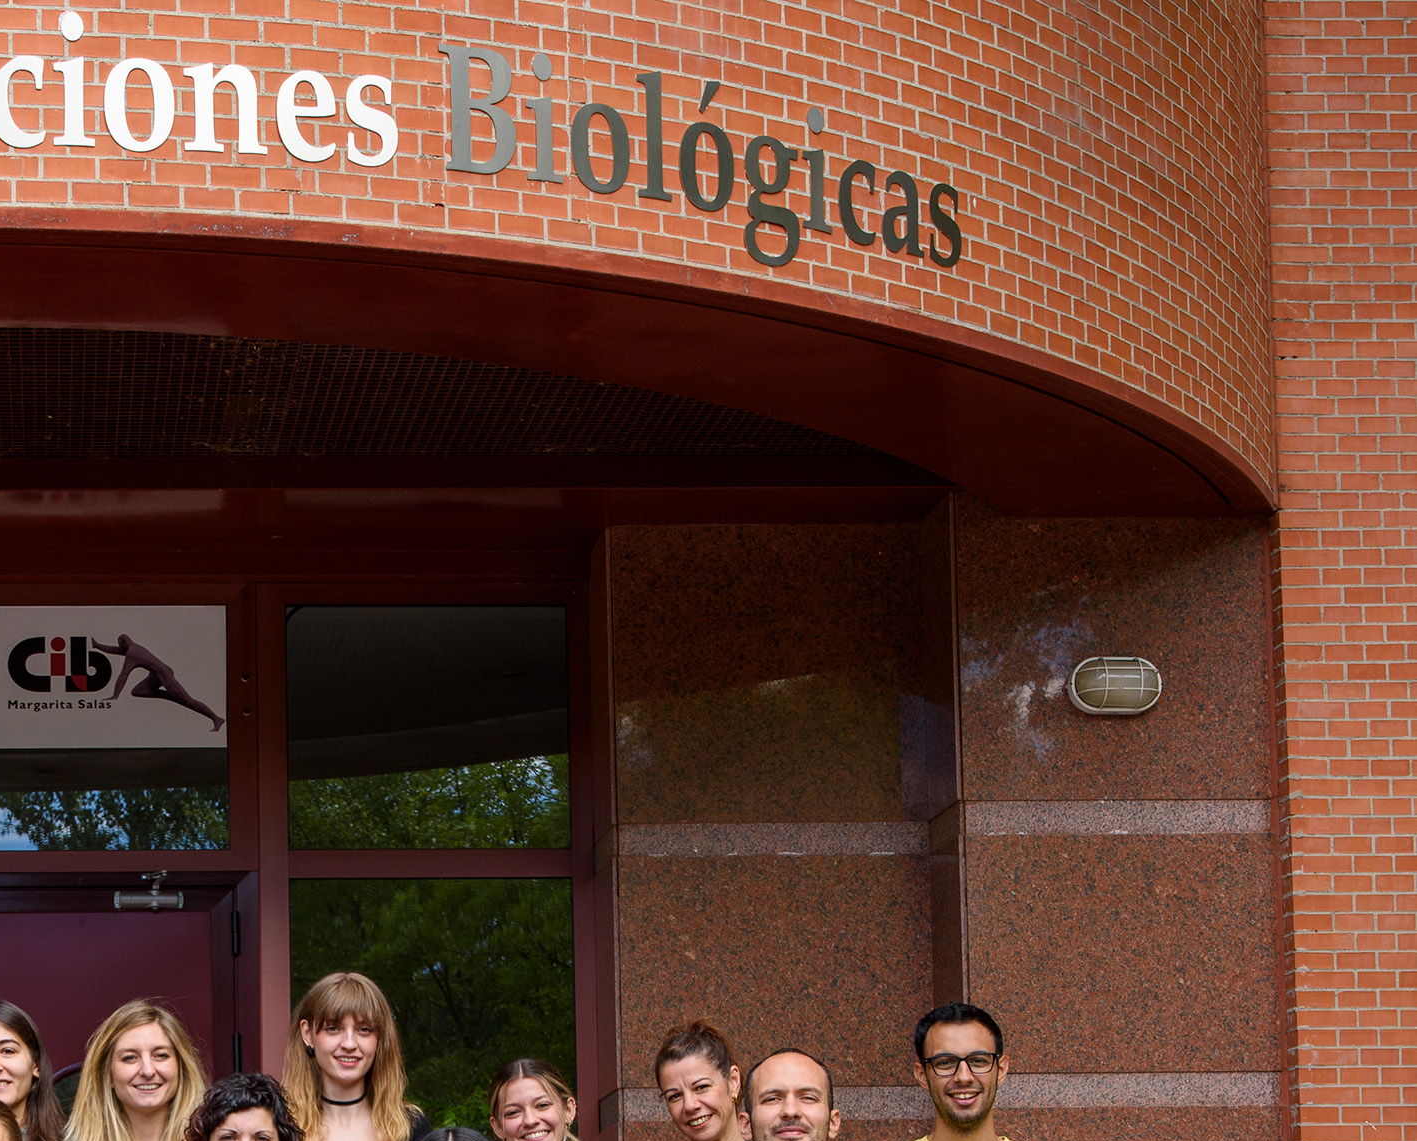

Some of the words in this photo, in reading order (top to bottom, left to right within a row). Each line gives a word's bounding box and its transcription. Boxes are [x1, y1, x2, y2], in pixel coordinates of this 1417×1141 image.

[438, 43, 962, 268] Biológicas
[7, 700, 73, 712] Margarita
[78, 700, 112, 710] Salas
